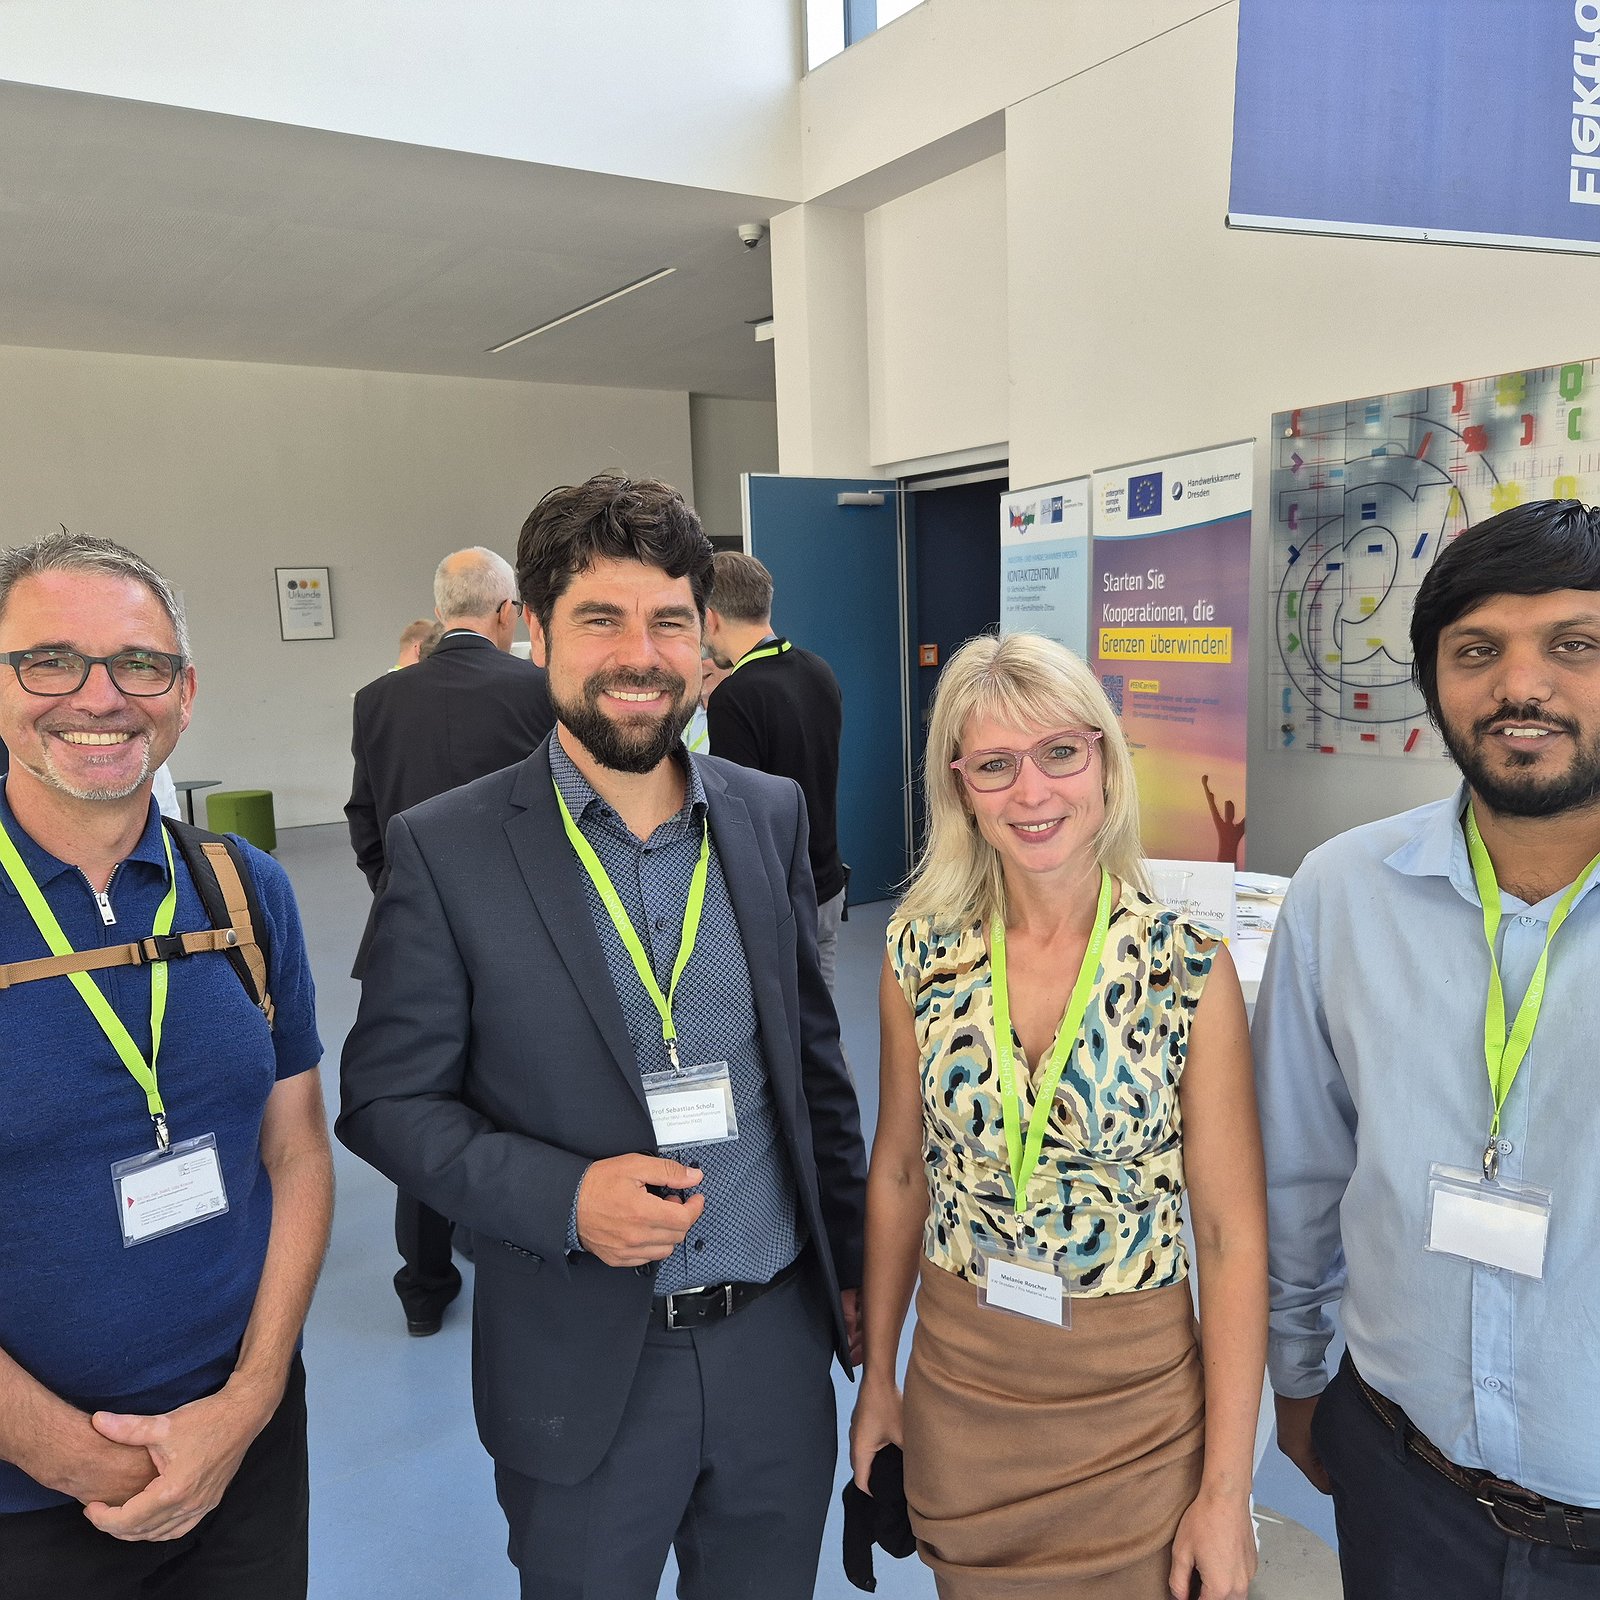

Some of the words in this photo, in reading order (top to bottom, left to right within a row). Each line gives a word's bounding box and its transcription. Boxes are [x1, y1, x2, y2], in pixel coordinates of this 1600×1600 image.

[1187, 472, 1241, 487] Handwerkskammer
[1187, 489, 1210, 499] Dresden
[1007, 567, 1060, 582] KONTAKTZENTRUM
[1103, 573, 1142, 592] Starten
[1147, 569, 1165, 590] Sie
[288, 590, 321, 600] Urkunde
[1102, 602, 1187, 627] Kooperationen,
[1193, 600, 1215, 621] die
[1102, 633, 1145, 653] Grenzen
[1150, 633, 1228, 655] überwinden!
[1000, 1046, 1014, 1096] SACHSEN!
[1040, 1055, 1064, 1101] SAXONY!
[665, 1105, 695, 1114] Sebastian
[695, 1102, 715, 1110] Scholz
[1000, 1274, 1023, 1285] Melanie
